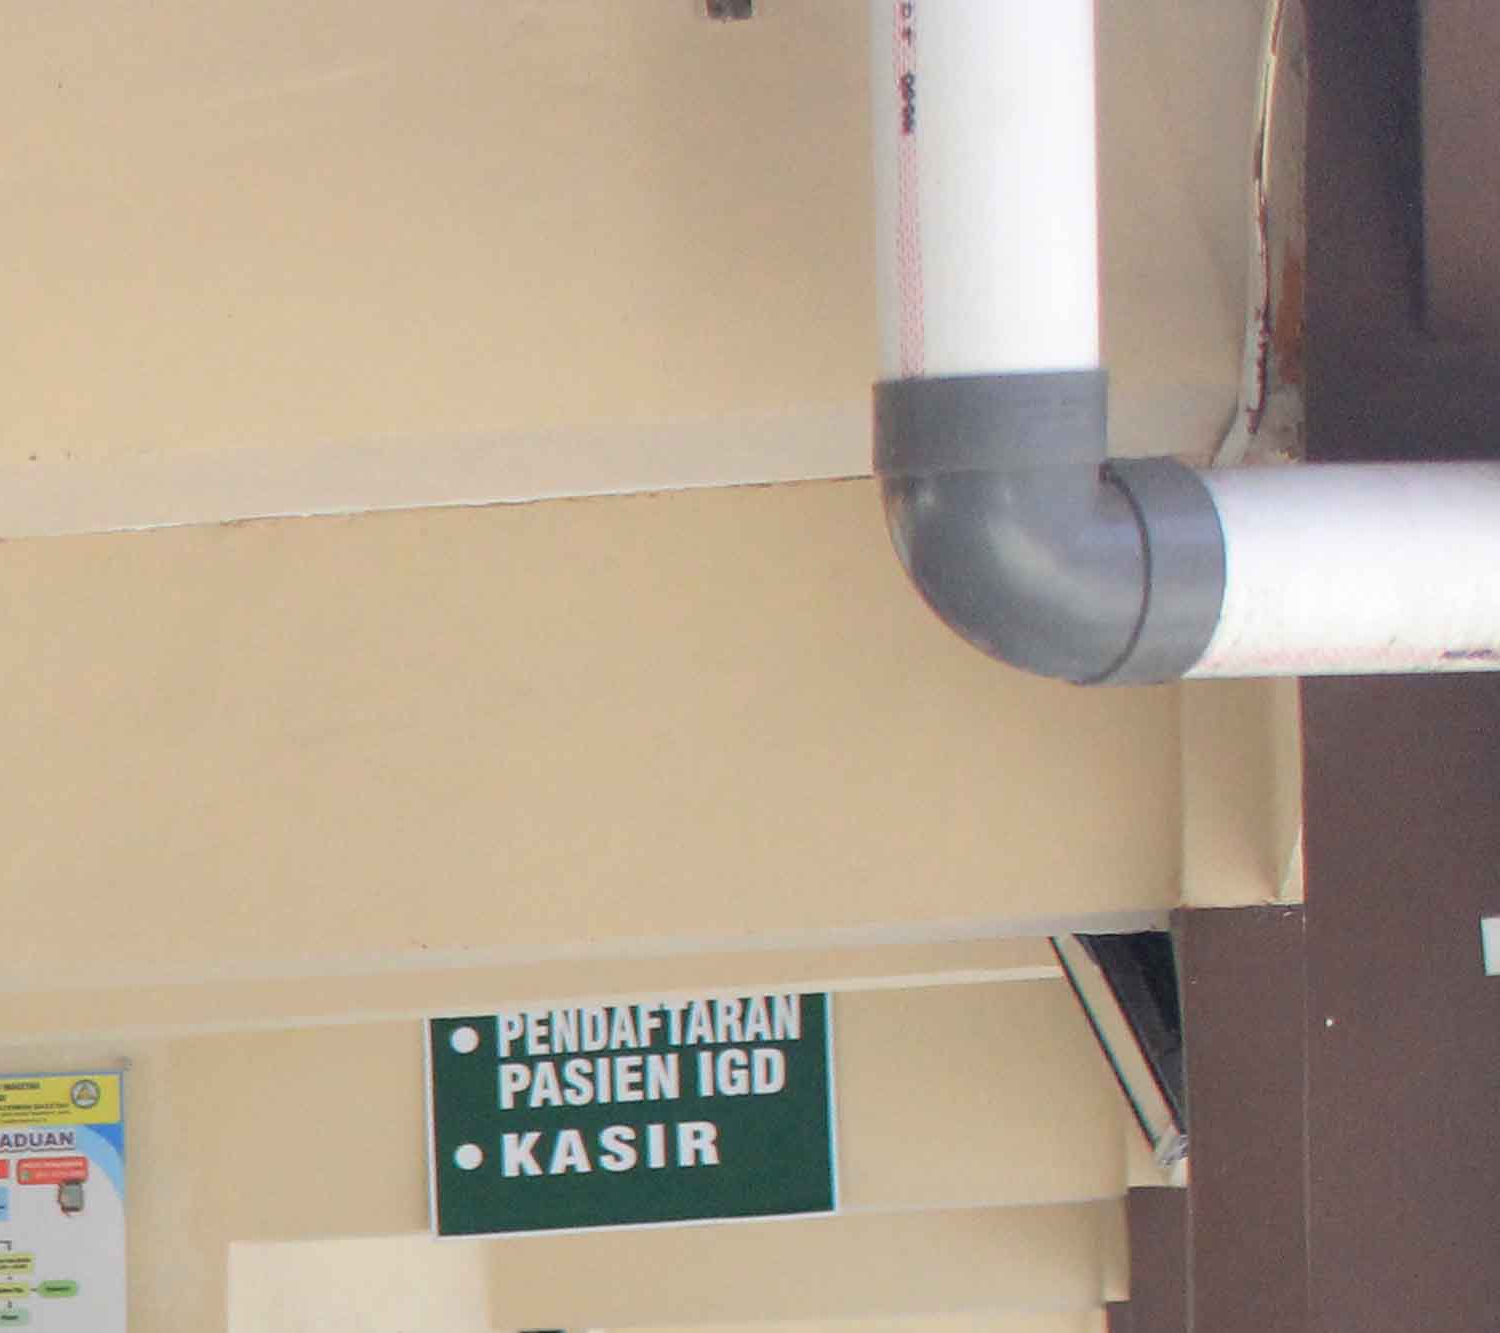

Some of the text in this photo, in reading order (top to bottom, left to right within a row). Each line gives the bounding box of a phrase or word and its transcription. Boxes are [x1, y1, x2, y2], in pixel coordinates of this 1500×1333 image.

[499, 994, 801, 1058] PENDAFTARAN
[500, 1047, 786, 1110] PASIEN IGD
[501, 1120, 720, 1179] KASIR
